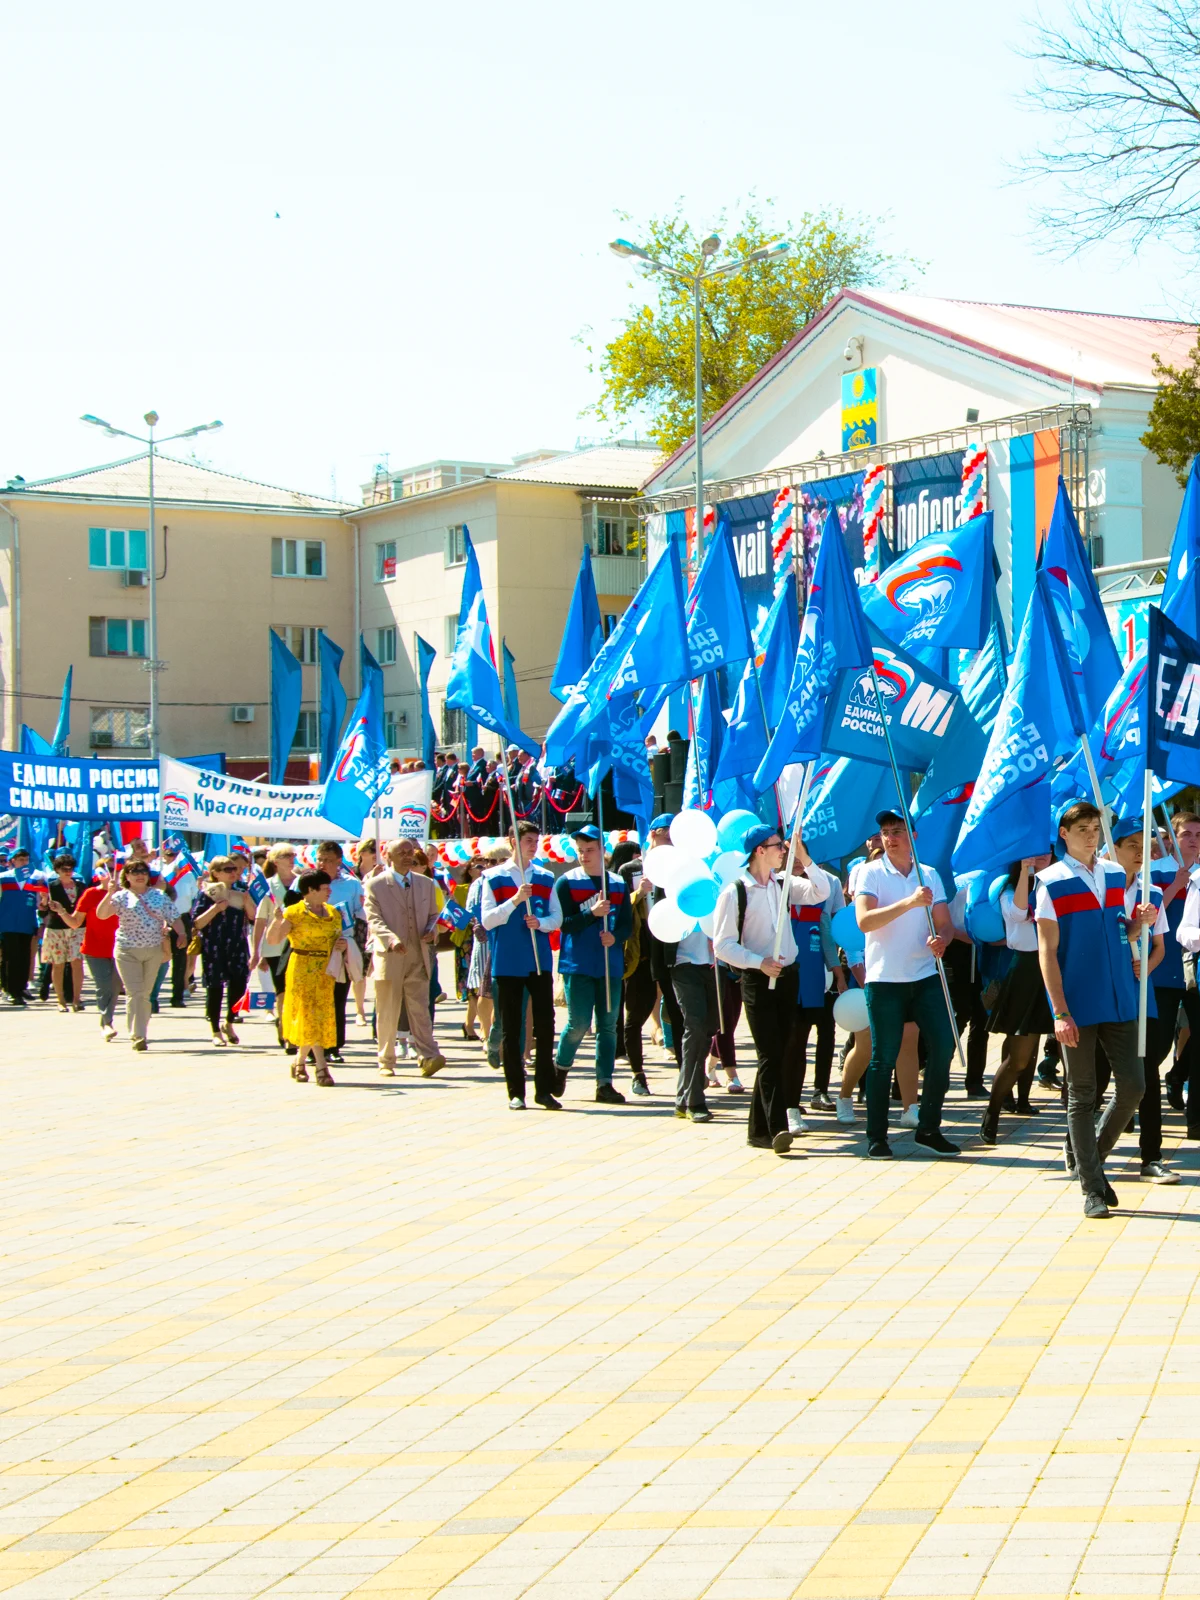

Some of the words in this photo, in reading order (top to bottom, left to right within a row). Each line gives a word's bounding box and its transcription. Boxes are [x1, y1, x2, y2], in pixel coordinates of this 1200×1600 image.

[845, 704, 892, 725] ЕДИНАЯ
[12, 762, 81, 788] ЕДИНАЯ
[89, 768, 159, 789] РОССИЯ
[9, 787, 89, 813] СИЛЬНАЯ
[194, 793, 323, 821] Краснодарско
